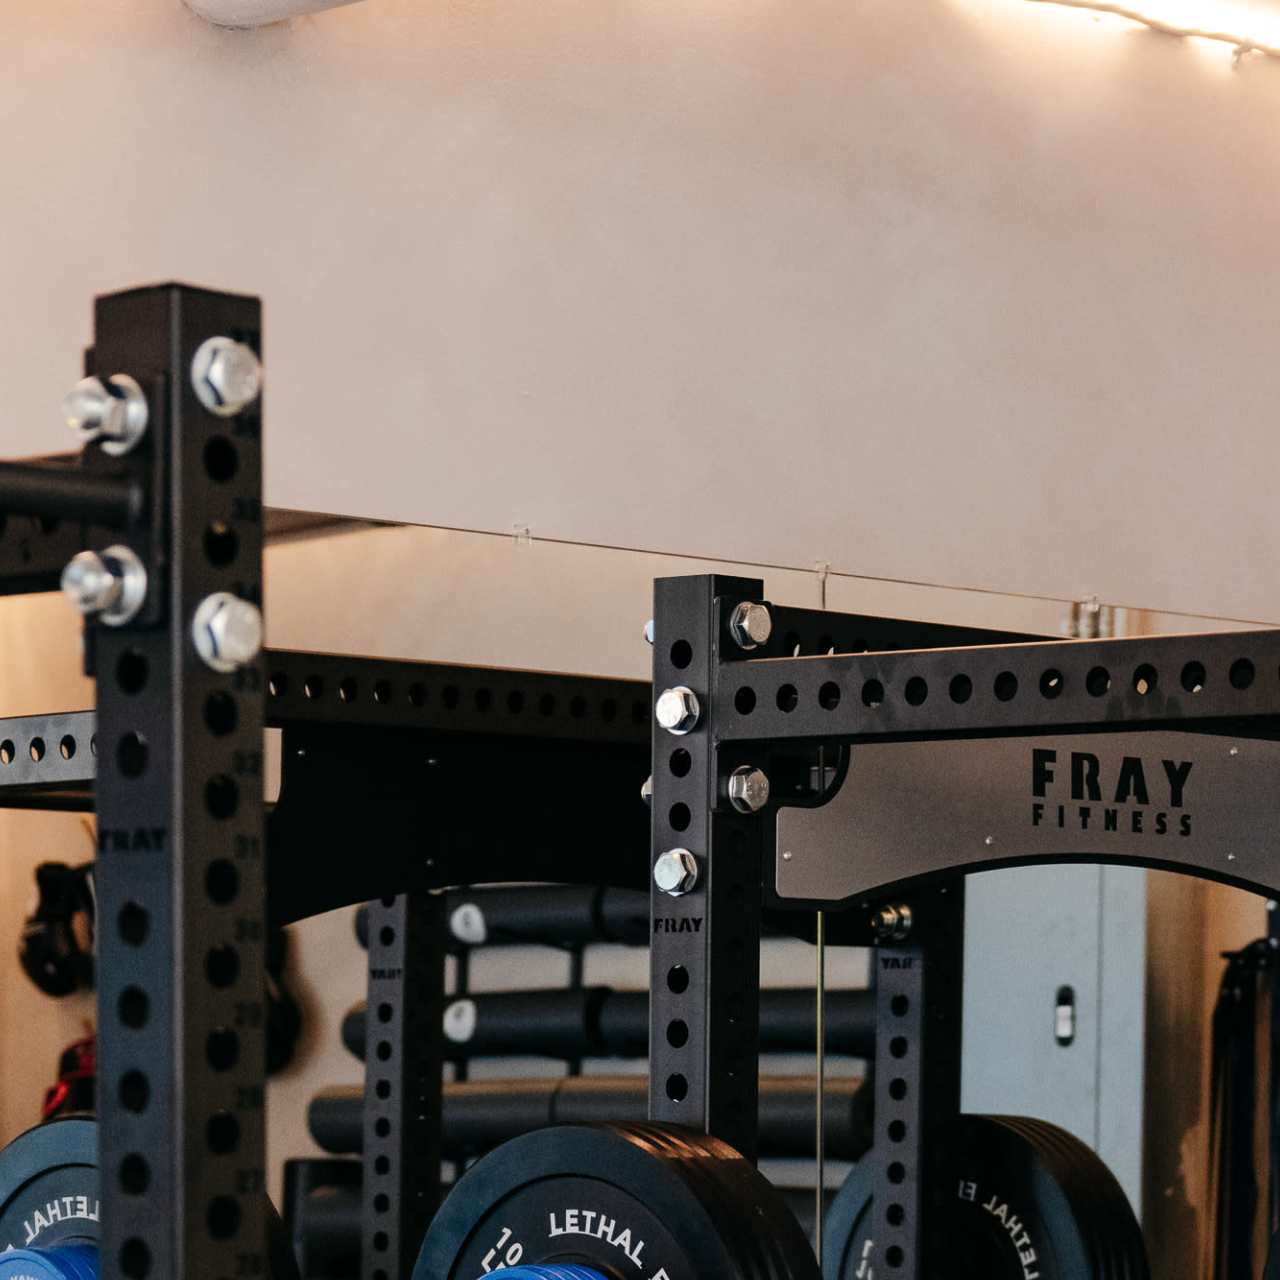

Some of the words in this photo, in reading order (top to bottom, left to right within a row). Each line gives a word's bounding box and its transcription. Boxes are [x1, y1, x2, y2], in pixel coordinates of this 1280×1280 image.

[1033, 749, 1193, 807] FRAY
[1033, 804, 1191, 836] FITNESS
[654, 917, 703, 933] FRAY
[496, 1227, 524, 1268] 10
[548, 1208, 648, 1269] LETHAL
